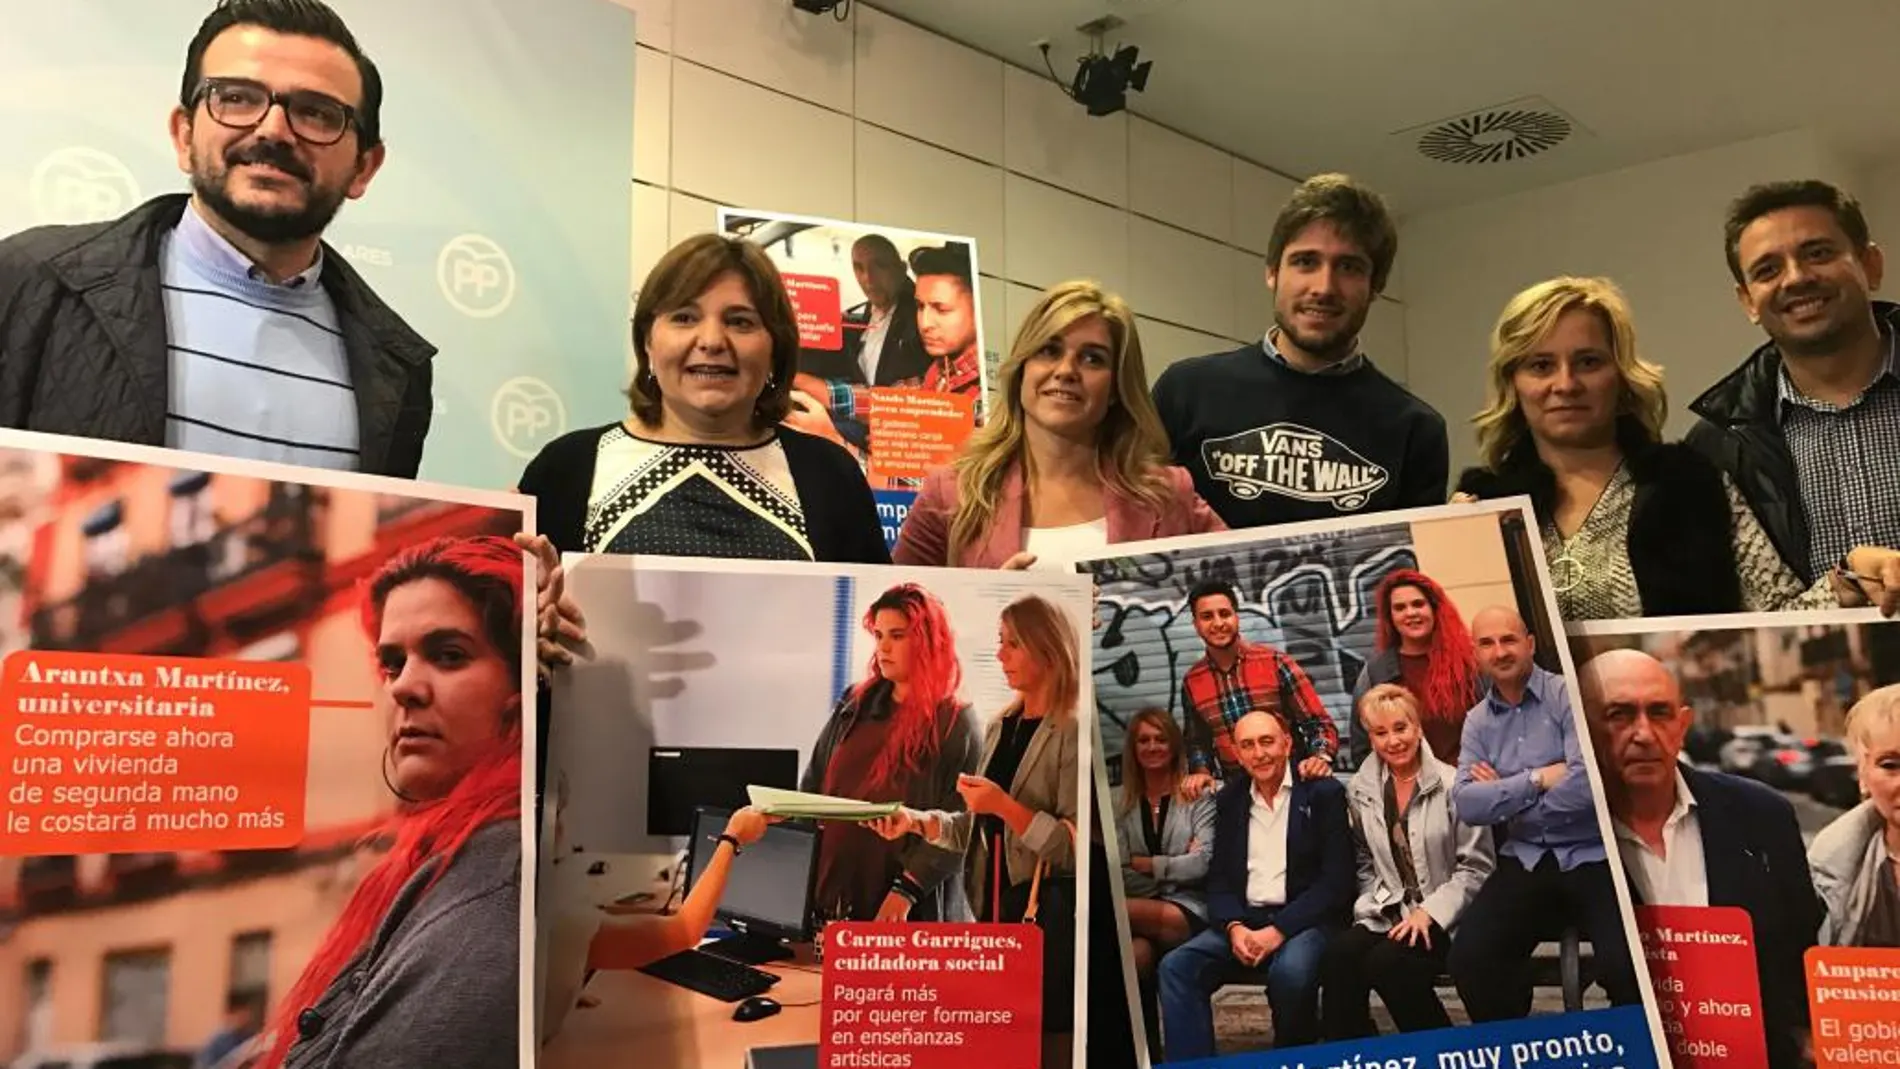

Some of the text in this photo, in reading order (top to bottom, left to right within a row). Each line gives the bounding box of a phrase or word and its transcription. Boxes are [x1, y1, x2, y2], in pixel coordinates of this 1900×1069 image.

[453, 258, 500, 297] PP
[508, 401, 551, 438] PP
[1260, 429, 1324, 459] VANS
[1263, 454, 1309, 492] THE
[18, 661, 291, 694] Arantxa Martínez,
[17, 692, 216, 717] universitaria
[15, 723, 235, 750] Comprarse ahora
[12, 753, 178, 775] una vivienda
[8, 780, 240, 808] de segunda mano
[7, 805, 286, 833] le costará mucho más
[836, 928, 1023, 951] Carme Garrigues,
[1655, 926, 1748, 947] Martínez,
[834, 952, 1004, 972] cuidadora social
[833, 983, 938, 1005] Pagará más
[832, 1006, 1013, 1026] por querer formarse
[1681, 999, 1692, 1017] y
[1698, 998, 1752, 1018] ahora
[832, 1027, 964, 1046] en enseñanzas
[1820, 1018, 1900, 1042] El gobi
[830, 1047, 912, 1068] artísticas
[1438, 1046, 1501, 1069] muy
[1511, 1029, 1625, 1069] pronto,
[1676, 1038, 1729, 1058] doble
